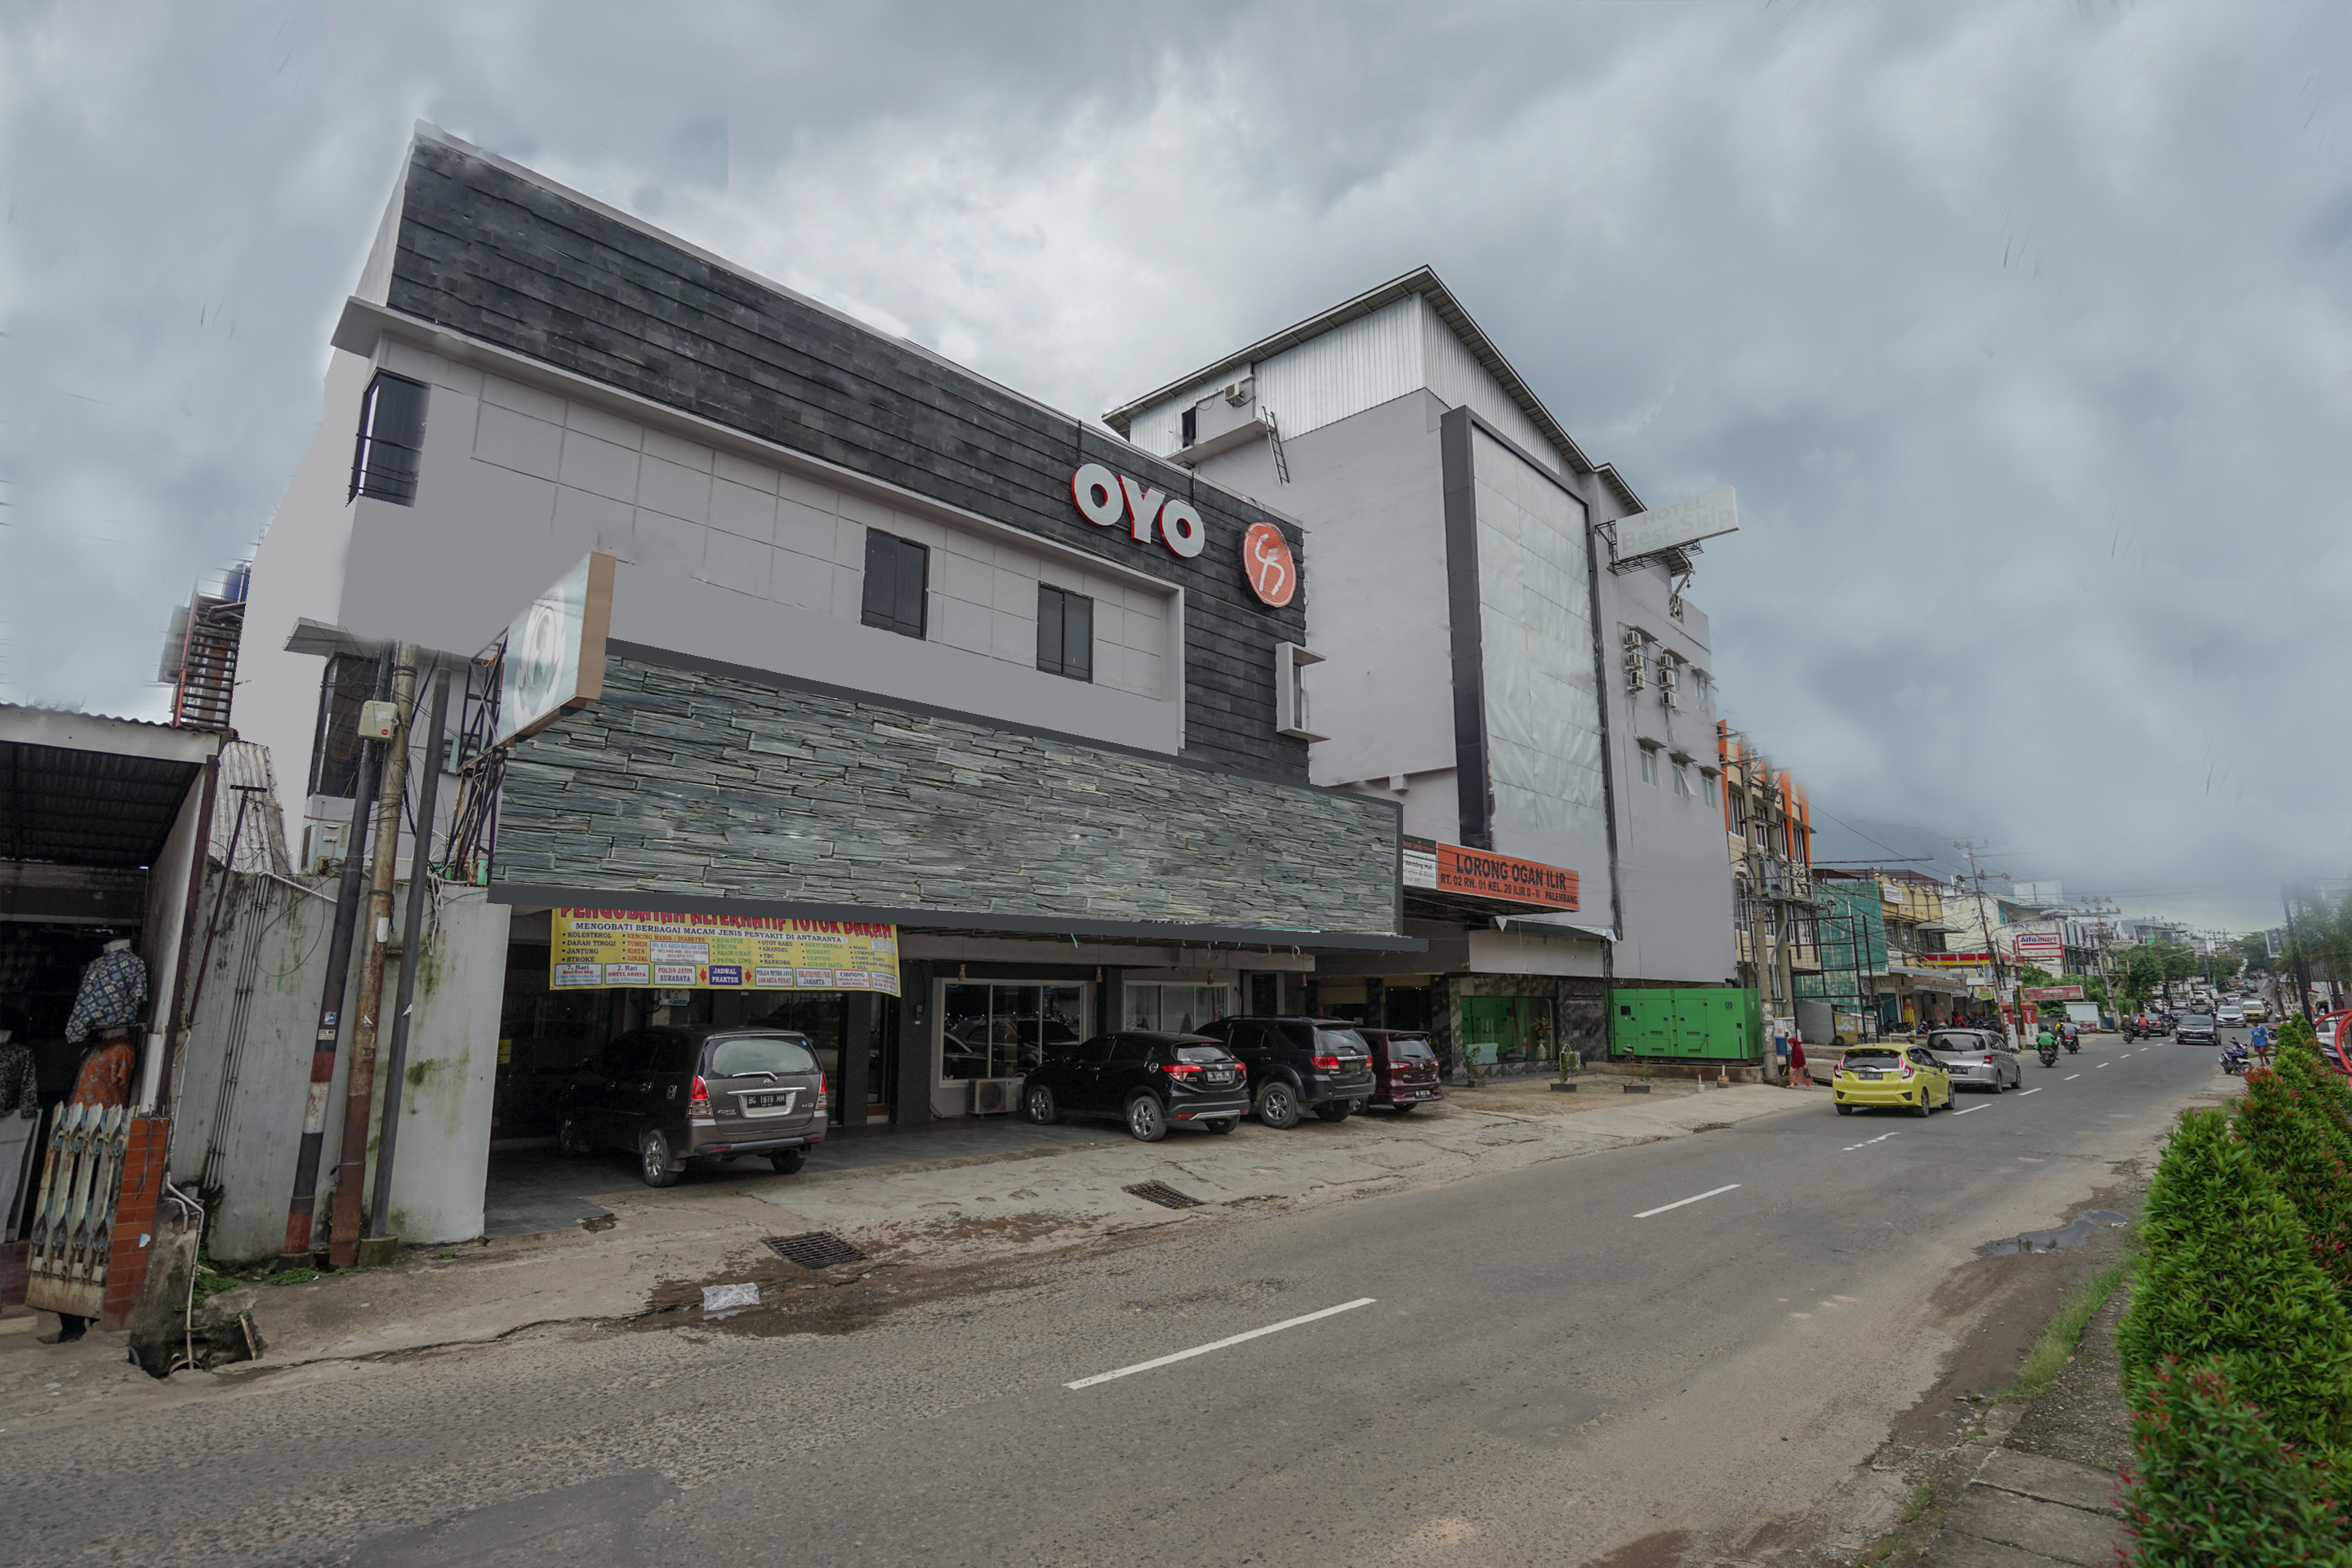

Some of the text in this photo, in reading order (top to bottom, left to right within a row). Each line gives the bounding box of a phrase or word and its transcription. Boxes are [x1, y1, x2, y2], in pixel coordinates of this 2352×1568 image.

[1071, 463, 1205, 558] OYO
[1642, 497, 1706, 525] HOTEL
[1621, 508, 1732, 551] Best Skip
[1456, 853, 1508, 880] LORONG
[1512, 863, 1544, 887] OGAN
[1546, 870, 1566, 890] ILIR
[1441, 873, 1452, 885] RT.
[1454, 875, 1462, 887] 02
[1463, 876, 1477, 889] RW.
[1478, 880, 1486, 890] 01
[1488, 880, 1503, 893] KEL.
[1503, 884, 1512, 894] 20
[1512, 884, 1526, 896] ILIR
[1544, 890, 1579, 905] PALEMBANG
[576, 922, 632, 931] MENGOBATI
[635, 924, 681, 933] BERBAGAI
[684, 927, 715, 935] MACAM
[717, 929, 742, 937] JENIS
[744, 931, 784, 940] PENYAKIT
[796, 934, 842, 943] ANTARANYA
[842, 921, 893, 939] DARAH
[748, 1096, 756, 1104] BG
[760, 1095, 774, 1103] 1878
